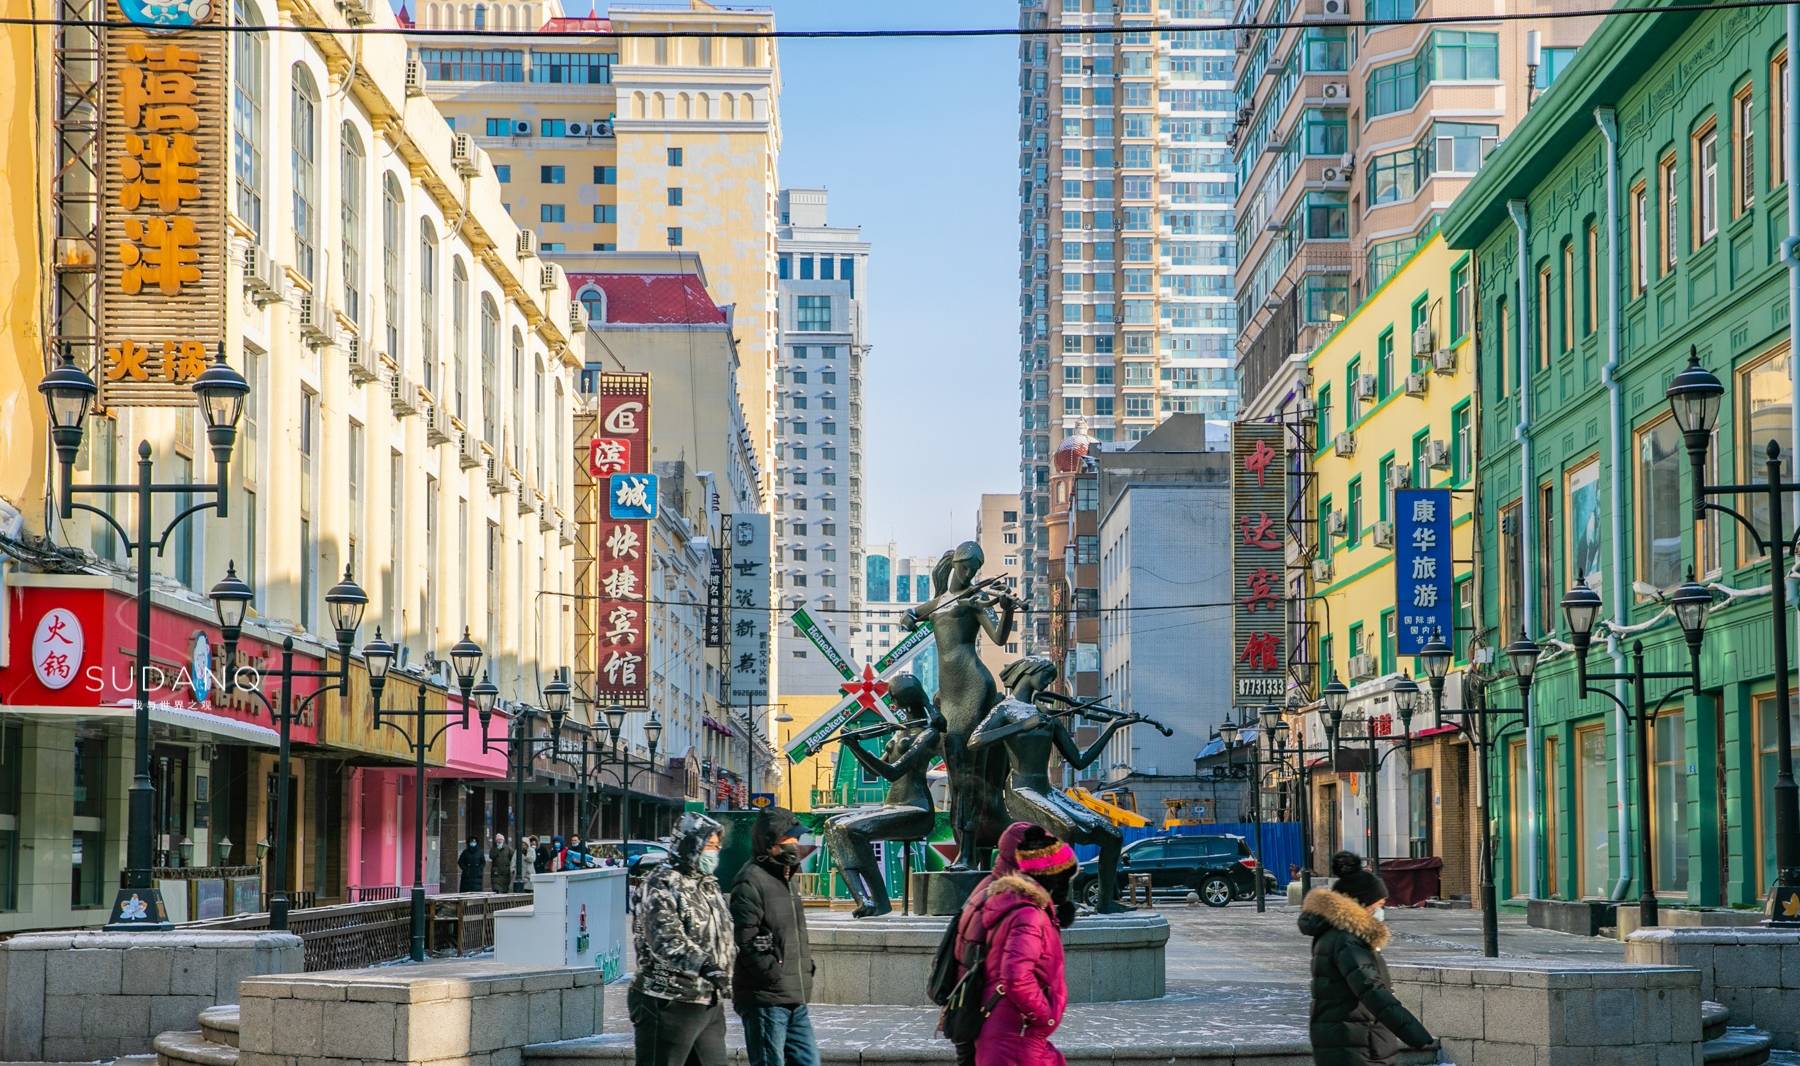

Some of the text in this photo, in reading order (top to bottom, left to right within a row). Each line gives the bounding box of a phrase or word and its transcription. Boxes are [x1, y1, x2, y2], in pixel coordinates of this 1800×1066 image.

[106, 340, 206, 382] 火锅
[1240, 440, 1281, 671] 中达宾馆
[1412, 499, 1437, 608] 康华旅游
[43, 615, 73, 679] 火锅
[807, 625, 840, 666] Heineken
[892, 625, 931, 661] Heineken
[1239, 679, 1284, 695] 87731333
[805, 713, 846, 748] Heineken
